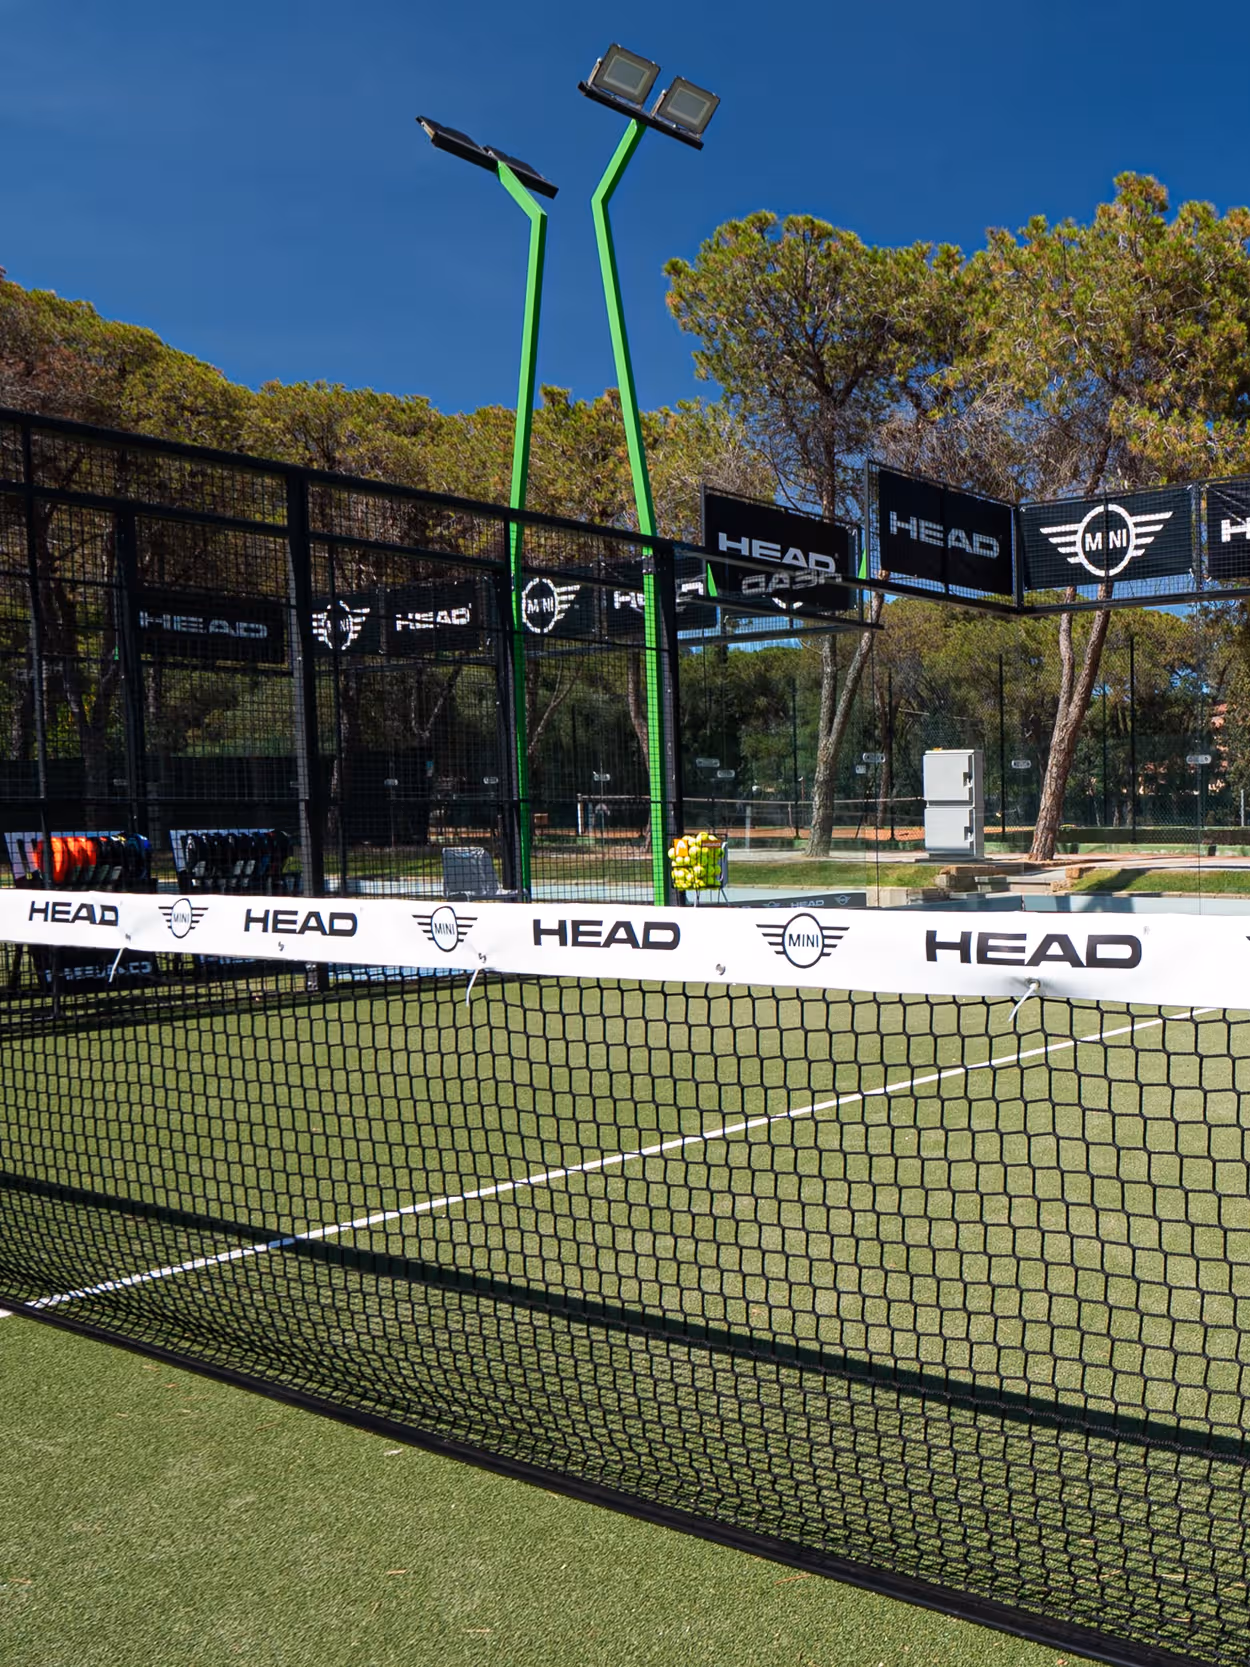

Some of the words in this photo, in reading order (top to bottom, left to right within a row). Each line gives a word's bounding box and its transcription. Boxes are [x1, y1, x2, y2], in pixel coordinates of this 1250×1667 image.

[890, 511, 1000, 559] HEAD
[1085, 529, 1127, 551] MNI
[718, 532, 836, 574] HEAD
[527, 597, 554, 614] MNI
[139, 611, 268, 638] HEAD
[395, 607, 470, 631] HEAD
[28, 900, 119, 926] HEAD
[173, 913, 190, 924] MINI
[243, 908, 358, 938] HEAD
[434, 923, 455, 935] MINI
[532, 918, 681, 951] HEAD
[788, 933, 819, 948] MINI
[925, 930, 1142, 969] HEAD
